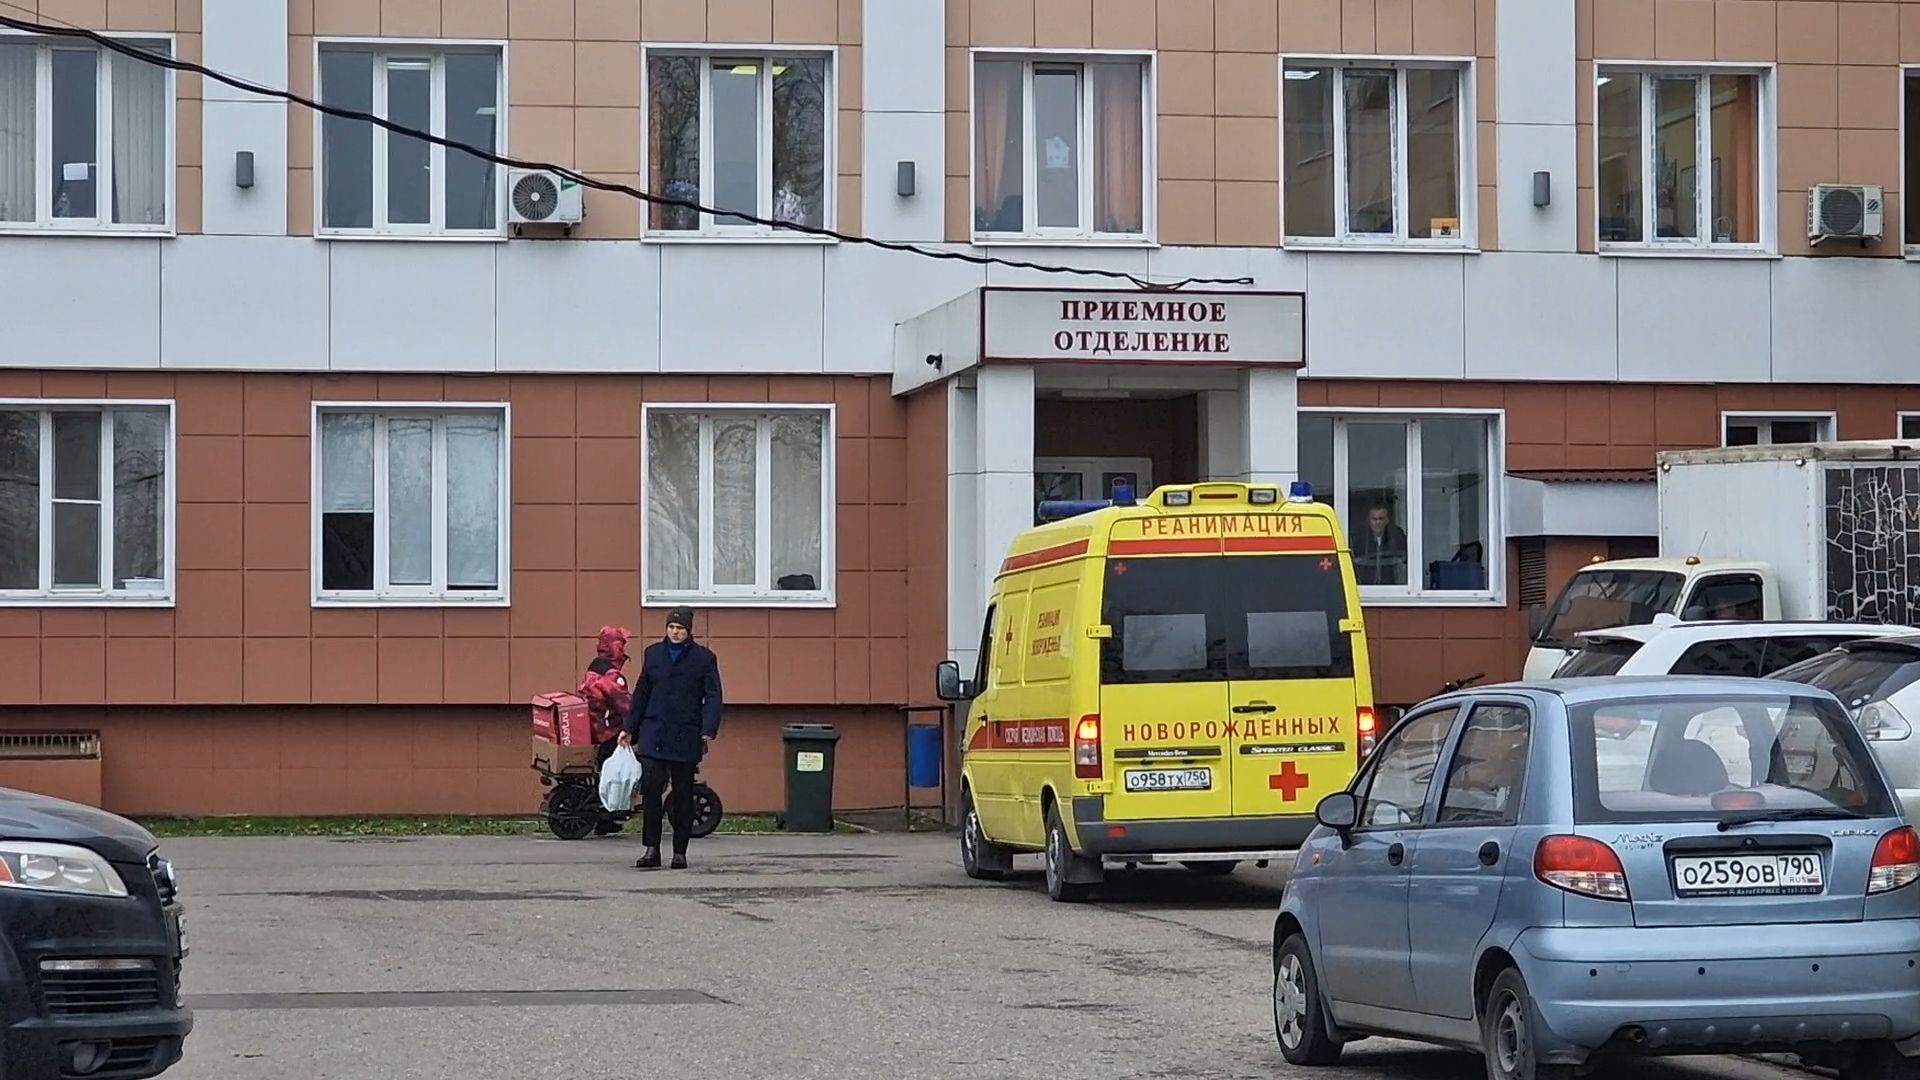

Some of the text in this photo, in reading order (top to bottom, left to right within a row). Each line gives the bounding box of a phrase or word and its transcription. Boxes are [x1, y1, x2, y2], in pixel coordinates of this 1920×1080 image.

[1061, 300, 1226, 322] ПРИЕМНОЕ
[1054, 331, 1230, 356] ОТДЕЛЕНИЕ
[1141, 515, 1304, 536] РЕАНИМАЦИЯ
[1123, 716, 1340, 742] НОВОРОЖДЕННЫХ
[1186, 770, 1206, 781] 750
[1779, 857, 1815, 876] 790
